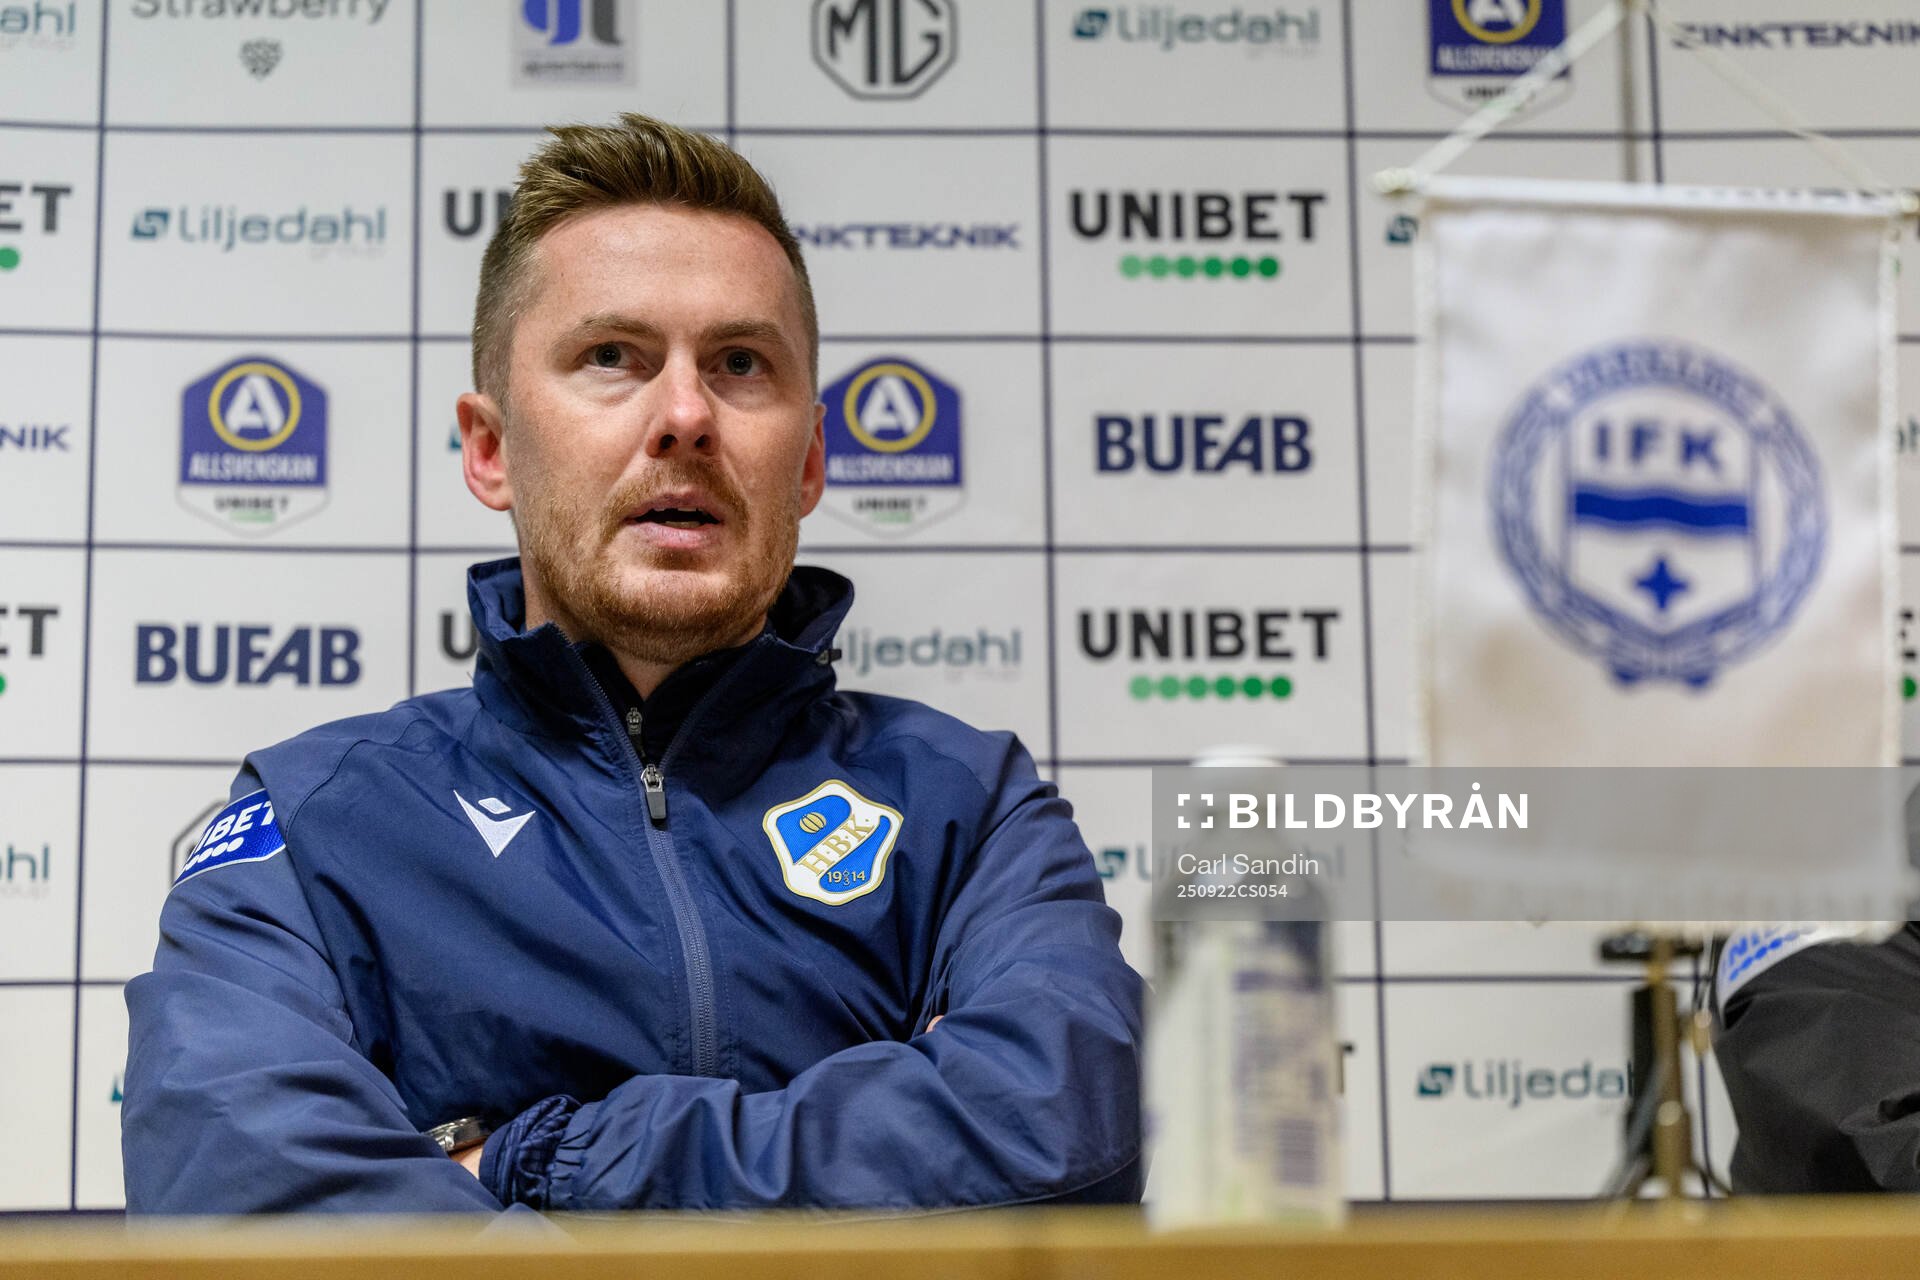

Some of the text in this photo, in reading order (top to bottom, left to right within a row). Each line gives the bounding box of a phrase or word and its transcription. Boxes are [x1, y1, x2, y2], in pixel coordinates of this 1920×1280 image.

[179, 206, 387, 252] Liljedahl
[1071, 190, 1326, 240] UNIBET
[189, 453, 318, 480] ALLSVENSKAN
[1095, 415, 1313, 475] BUFAB
[1594, 419, 1723, 472] IFK
[135, 623, 363, 686] BUFAB
[1078, 609, 1340, 661] UNIBET
